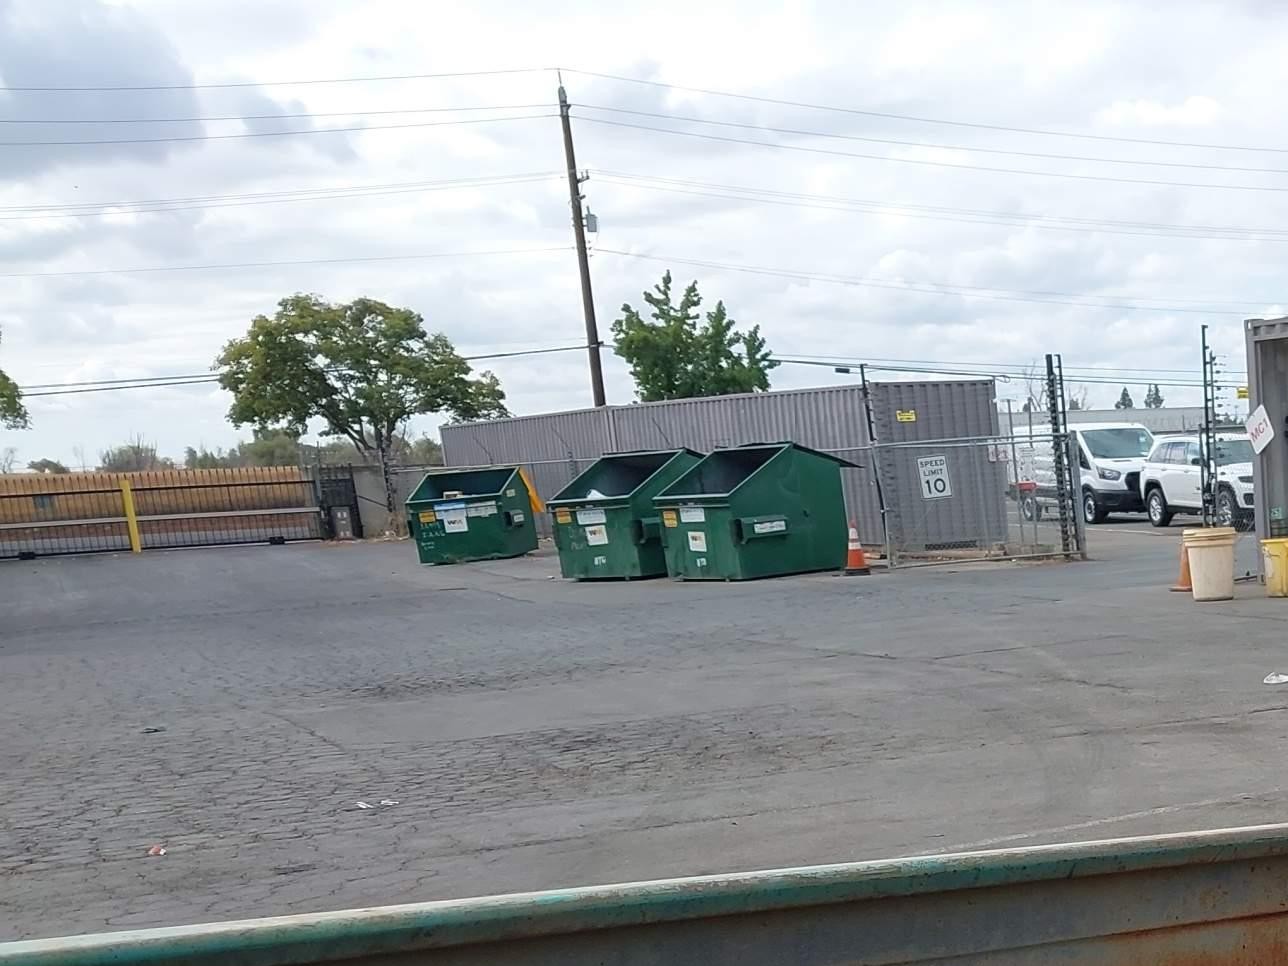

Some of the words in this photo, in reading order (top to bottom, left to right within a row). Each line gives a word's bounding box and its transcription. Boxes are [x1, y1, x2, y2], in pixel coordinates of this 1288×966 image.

[1250, 418, 1269, 443] MC1
[920, 459, 945, 468] SPEED
[923, 468, 943, 477] LIMIT
[925, 478, 946, 495] 10
